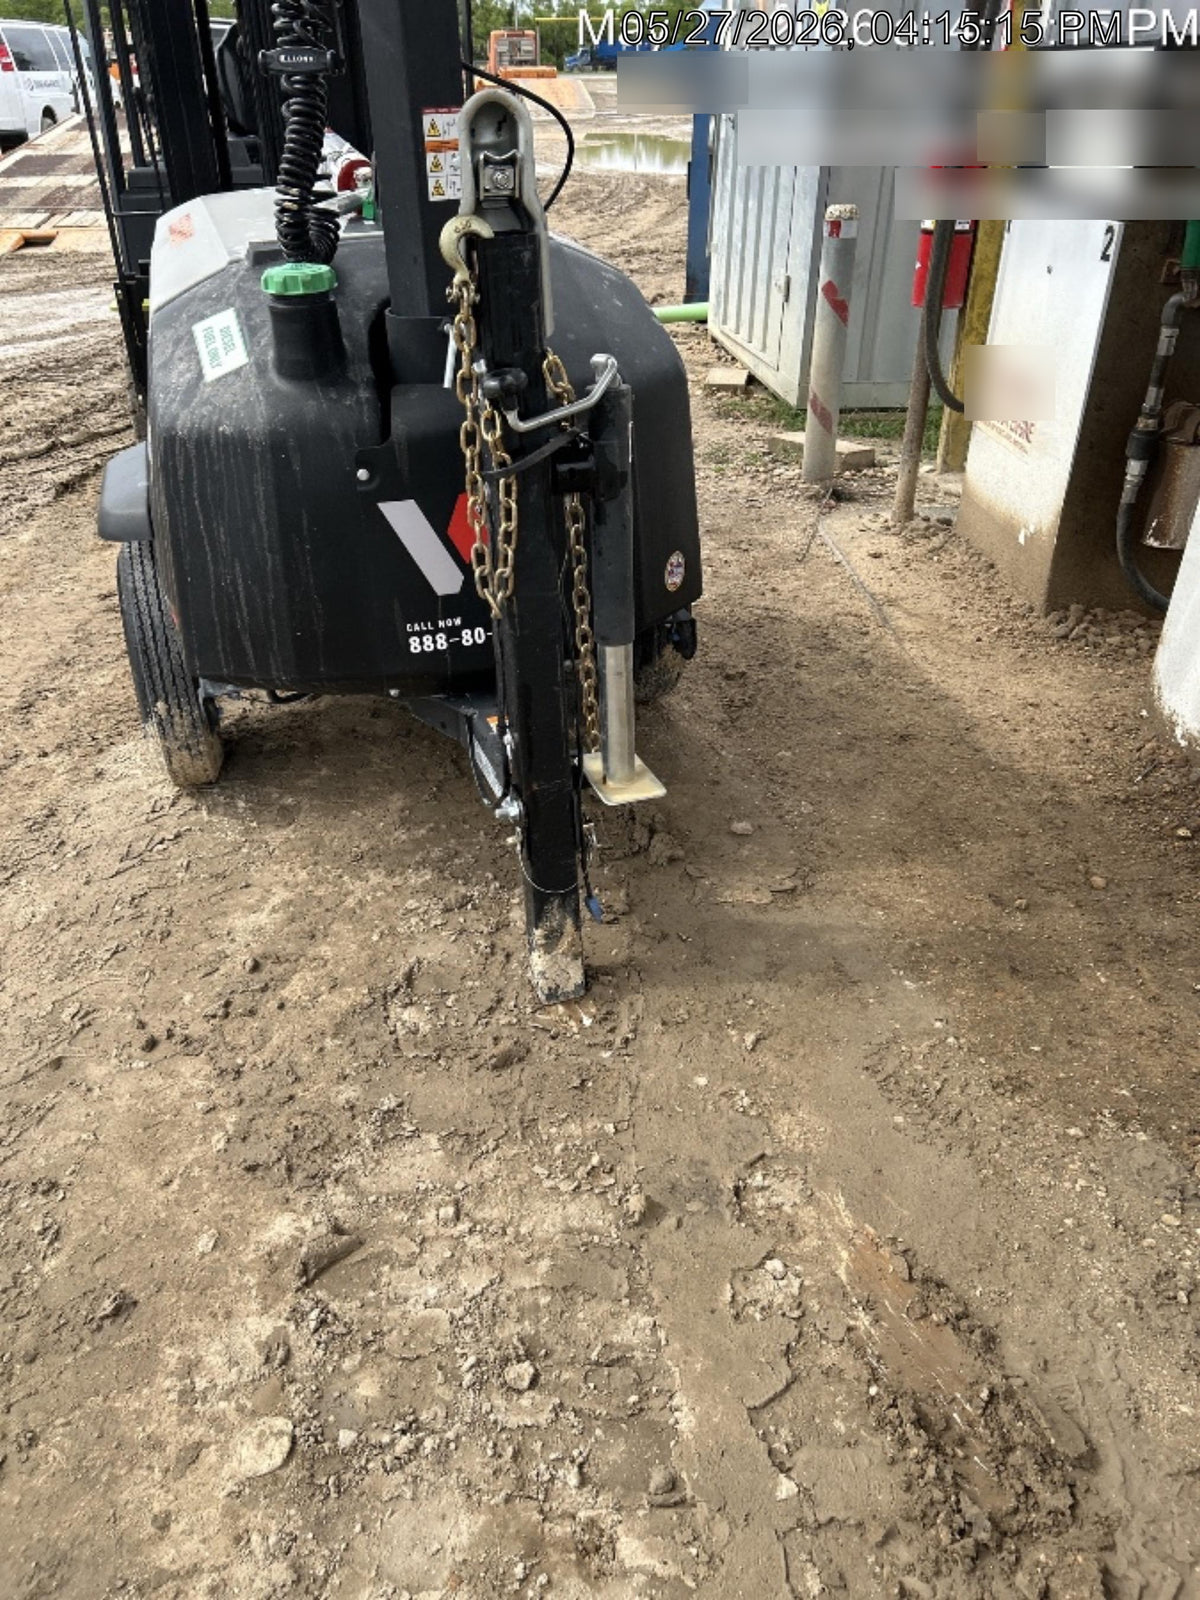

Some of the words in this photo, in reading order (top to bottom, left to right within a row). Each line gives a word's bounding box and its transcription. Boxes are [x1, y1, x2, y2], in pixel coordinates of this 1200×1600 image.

[1100, 225, 1114, 262] 2
[406, 621, 434, 632] CALL
[438, 616, 463, 628] NOW
